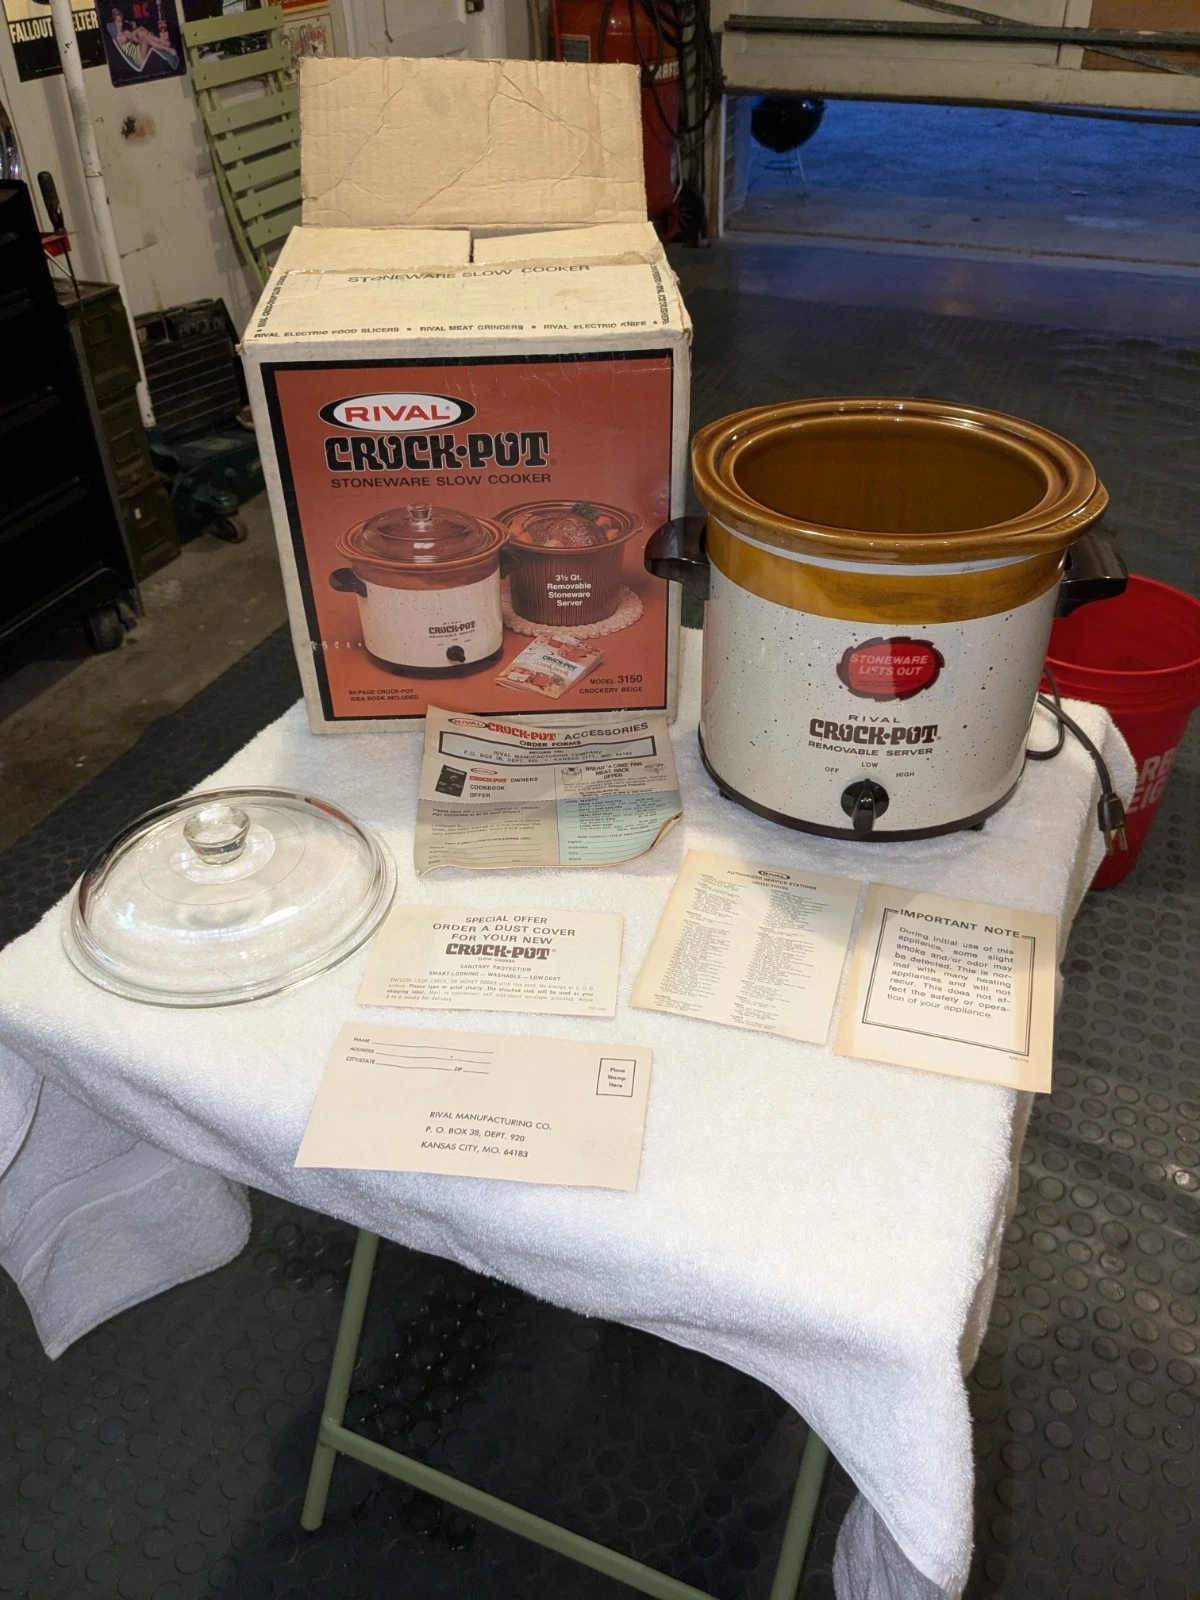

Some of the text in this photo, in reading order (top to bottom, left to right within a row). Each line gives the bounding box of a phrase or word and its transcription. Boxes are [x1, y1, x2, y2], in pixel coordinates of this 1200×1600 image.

[8, 10, 99, 44] FALLOUT ELTER
[347, 264, 590, 283] STONEWARE SLOW COOKER
[344, 404, 450, 422] RIVAL
[331, 473, 551, 489] STONEWARE SLOW COOKER
[547, 582, 592, 590] Removable
[548, 591, 591, 599] Stoneware
[850, 654, 929, 665] STONEWARE
[618, 674, 643, 684] 3150
[859, 666, 923, 676] LIFTS OUT
[848, 714, 901, 723] RIVAL
[564, 722, 649, 740] ACCESSORIES
[808, 740, 933, 757] REMOVABLE SERVER
[764, 876, 787, 885] SERVICE
[789, 882, 817, 890] STATIONS
[466, 916, 548, 924] SPECIAL OFFER
[900, 909, 1020, 938] IMPORTANT NOTE
[432, 923, 477, 932] ORDER
[494, 925, 529, 933] DUST
[532, 928, 576, 937] COVER
[900, 927, 929, 940] During
[934, 936, 958, 946] initial
[482, 934, 518, 943] YOUR
[522, 936, 554, 945] NEW
[894, 952, 906, 960] be
[910, 956, 952, 970] detected.
[957, 966, 977, 974] This
[896, 944, 1013, 972] smoke and/or odor may
[953, 950, 978, 958] some
[988, 955, 1014, 963] slight
[892, 970, 1011, 996] appliances and will not
[917, 966, 936, 974] with
[944, 972, 969, 981] many
[977, 976, 1011, 989] heating
[890, 978, 917, 987] recur.
[924, 982, 943, 992] This
[948, 988, 970, 997] does
[888, 985, 907, 994] fect
[911, 989, 926, 997] the
[930, 992, 959, 1004] safety
[978, 1002, 1010, 1012] opera-
[888, 994, 904, 1002] tion
[920, 1000, 942, 1009] your
[944, 1004, 994, 1019] appliance.
[349, 1046, 375, 1054] ADDRESS
[346, 1056, 376, 1064] CITY/STATE
[430, 1111, 552, 1131] RIVAL MANUFACTURING CO.
[436, 1126, 446, 1134] O.
[469, 1128, 482, 1138] 38,
[484, 1130, 508, 1140] DEPT.
[510, 1134, 525, 1142] 920
[421, 1141, 529, 1158] KANSAS CITY, MO. 64183
